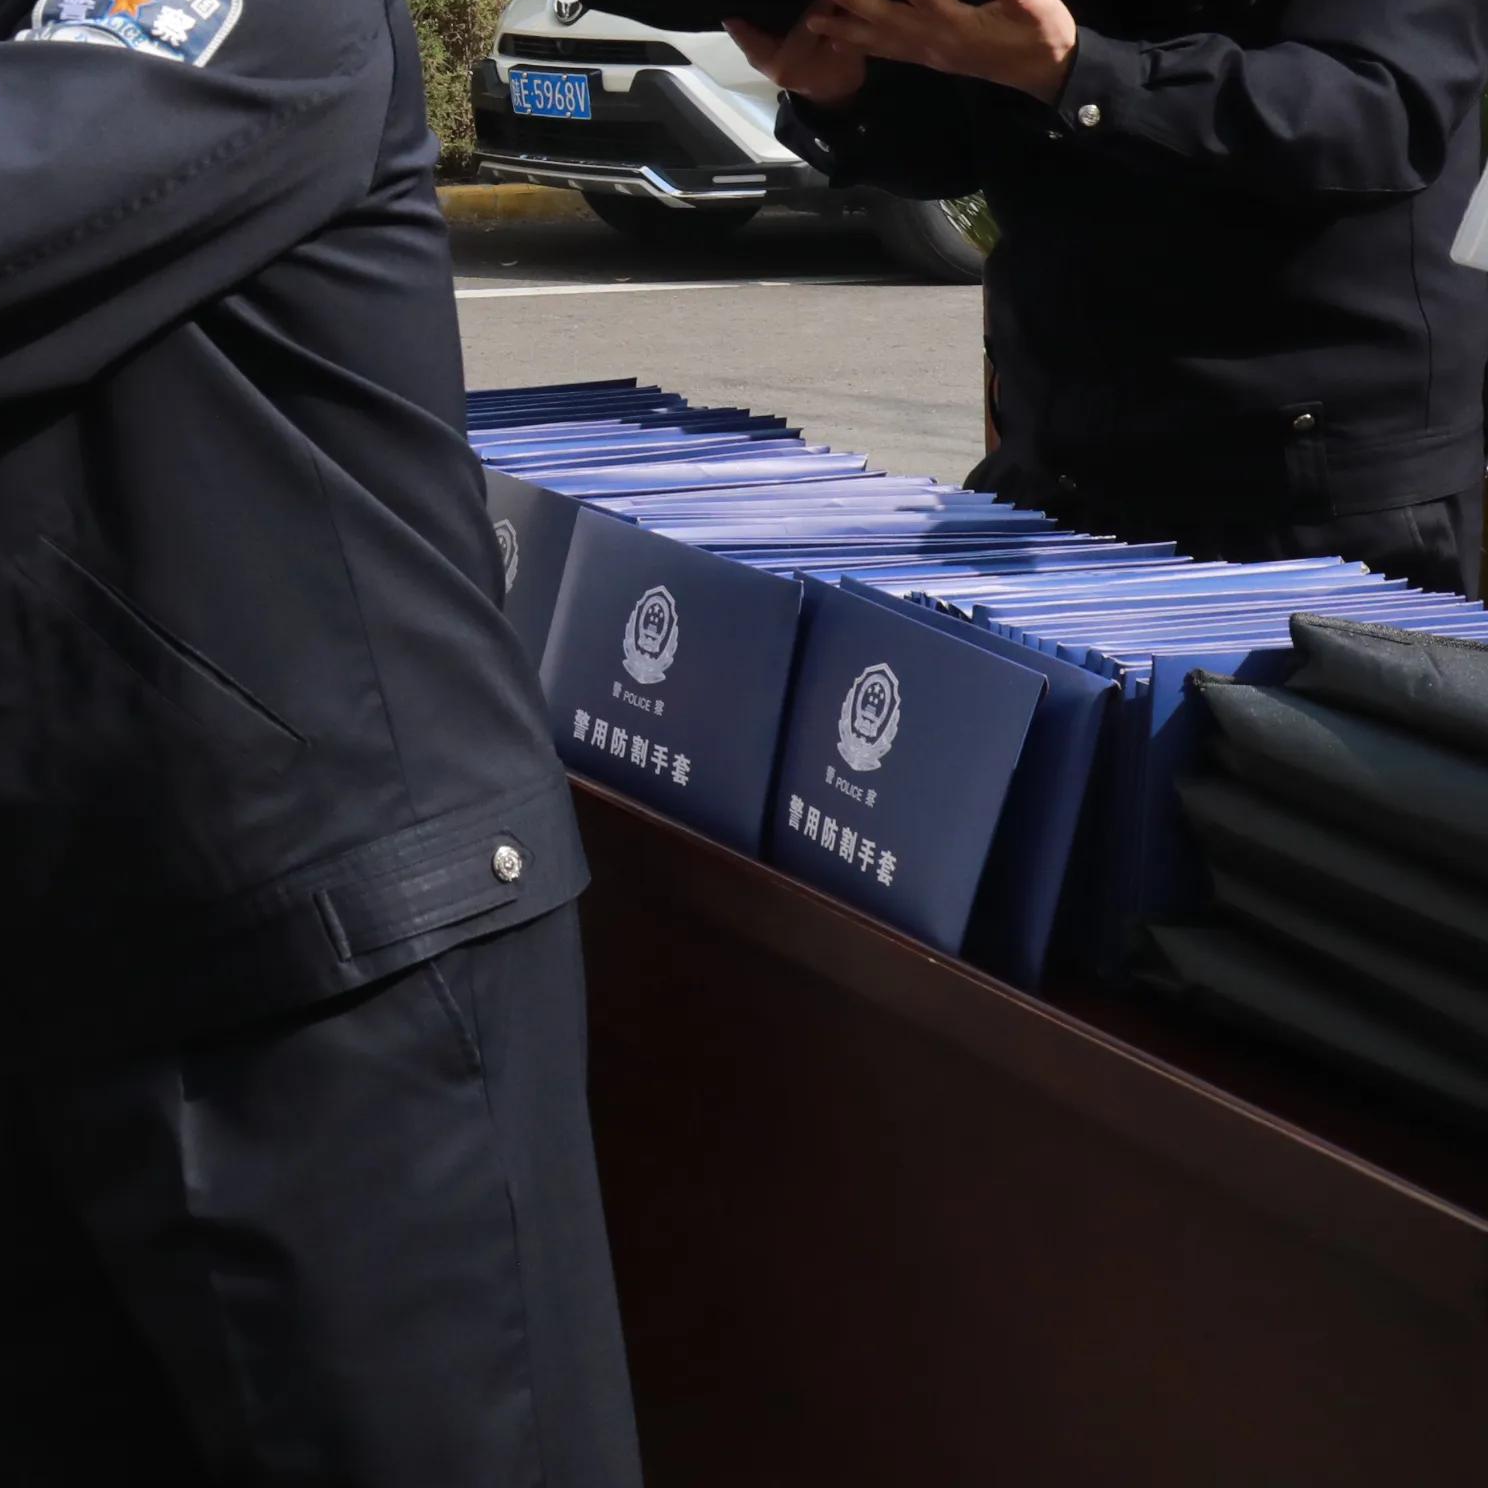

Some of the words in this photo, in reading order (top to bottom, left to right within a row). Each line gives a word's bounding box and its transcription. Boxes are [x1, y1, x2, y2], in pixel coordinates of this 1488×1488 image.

[151, 5, 197, 48] 察
[623, 690, 652, 713] POLICE
[653, 699, 666, 718] 察
[573, 708, 692, 788] 警用防割手套
[835, 776, 865, 803] POLICE
[865, 788, 878, 809] 察
[787, 793, 898, 888] 警用防割手套
